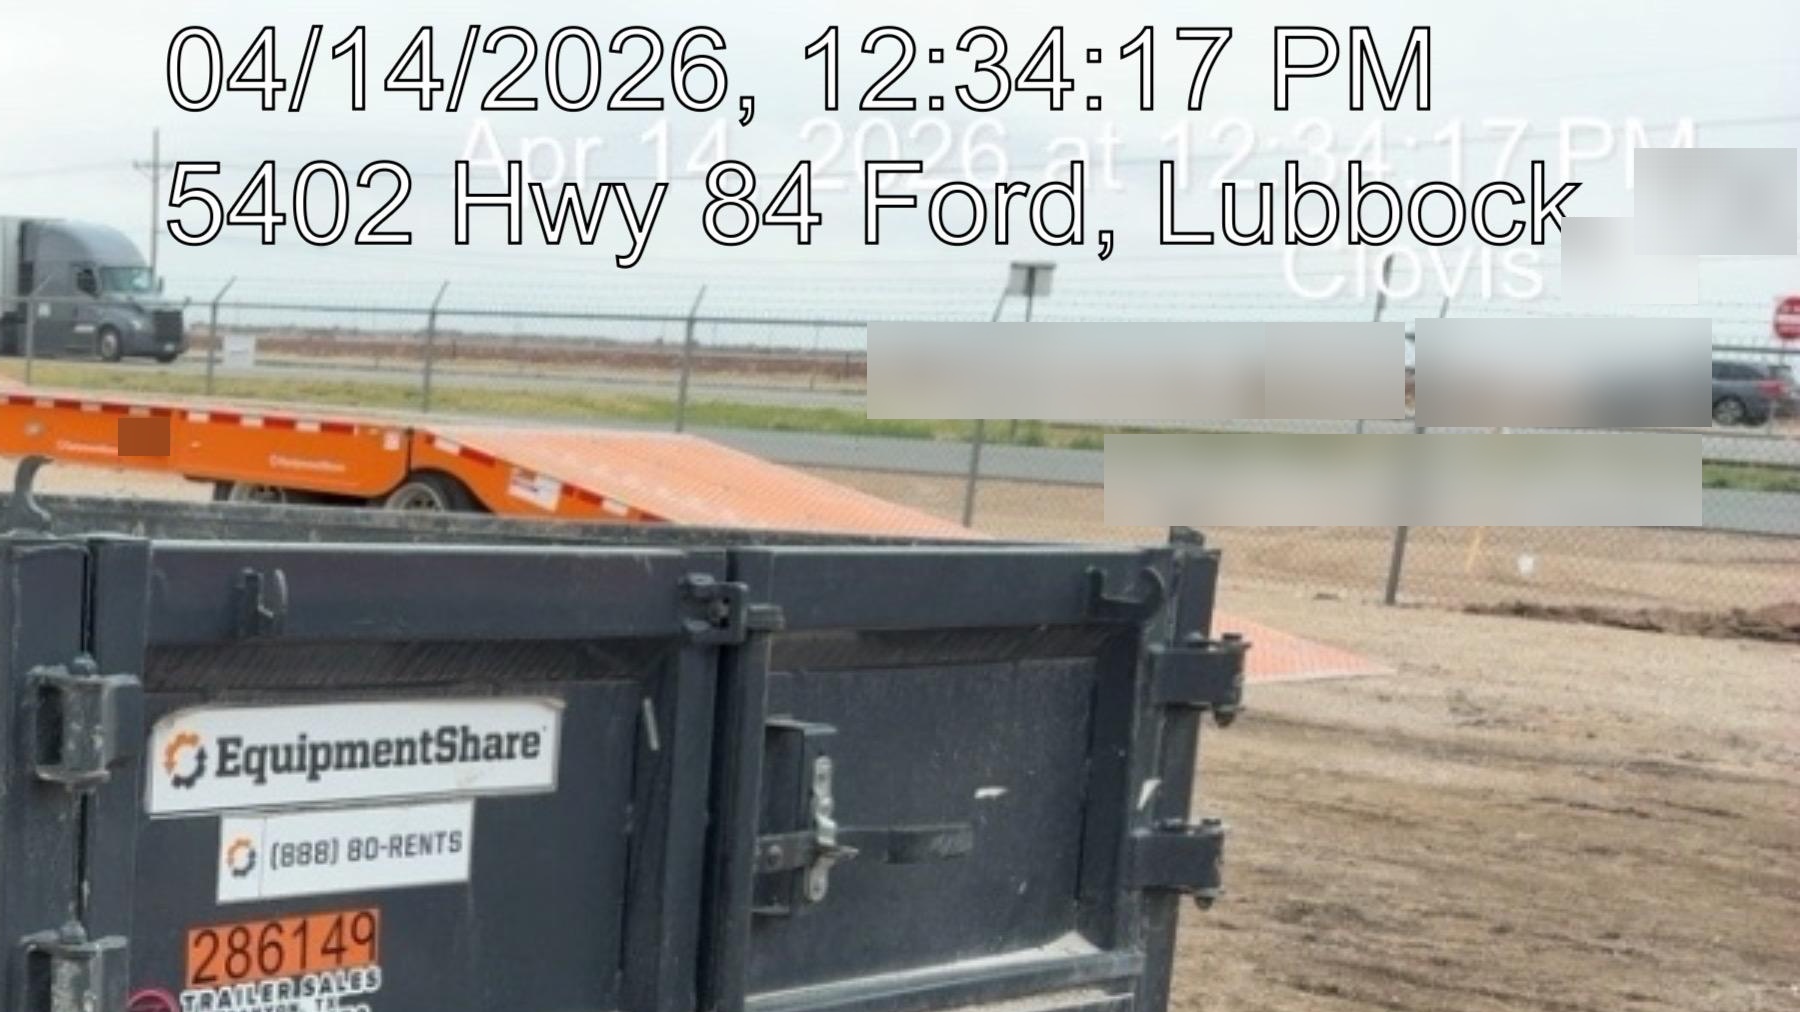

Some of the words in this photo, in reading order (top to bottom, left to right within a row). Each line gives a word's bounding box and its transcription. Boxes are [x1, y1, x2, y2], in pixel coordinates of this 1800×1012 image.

[215, 725, 542, 785] EquipmentShare
[269, 837, 340, 870] (888)
[347, 830, 463, 861] 80-RENTS
[191, 910, 376, 985] 286149
[301, 967, 382, 998] SALES
